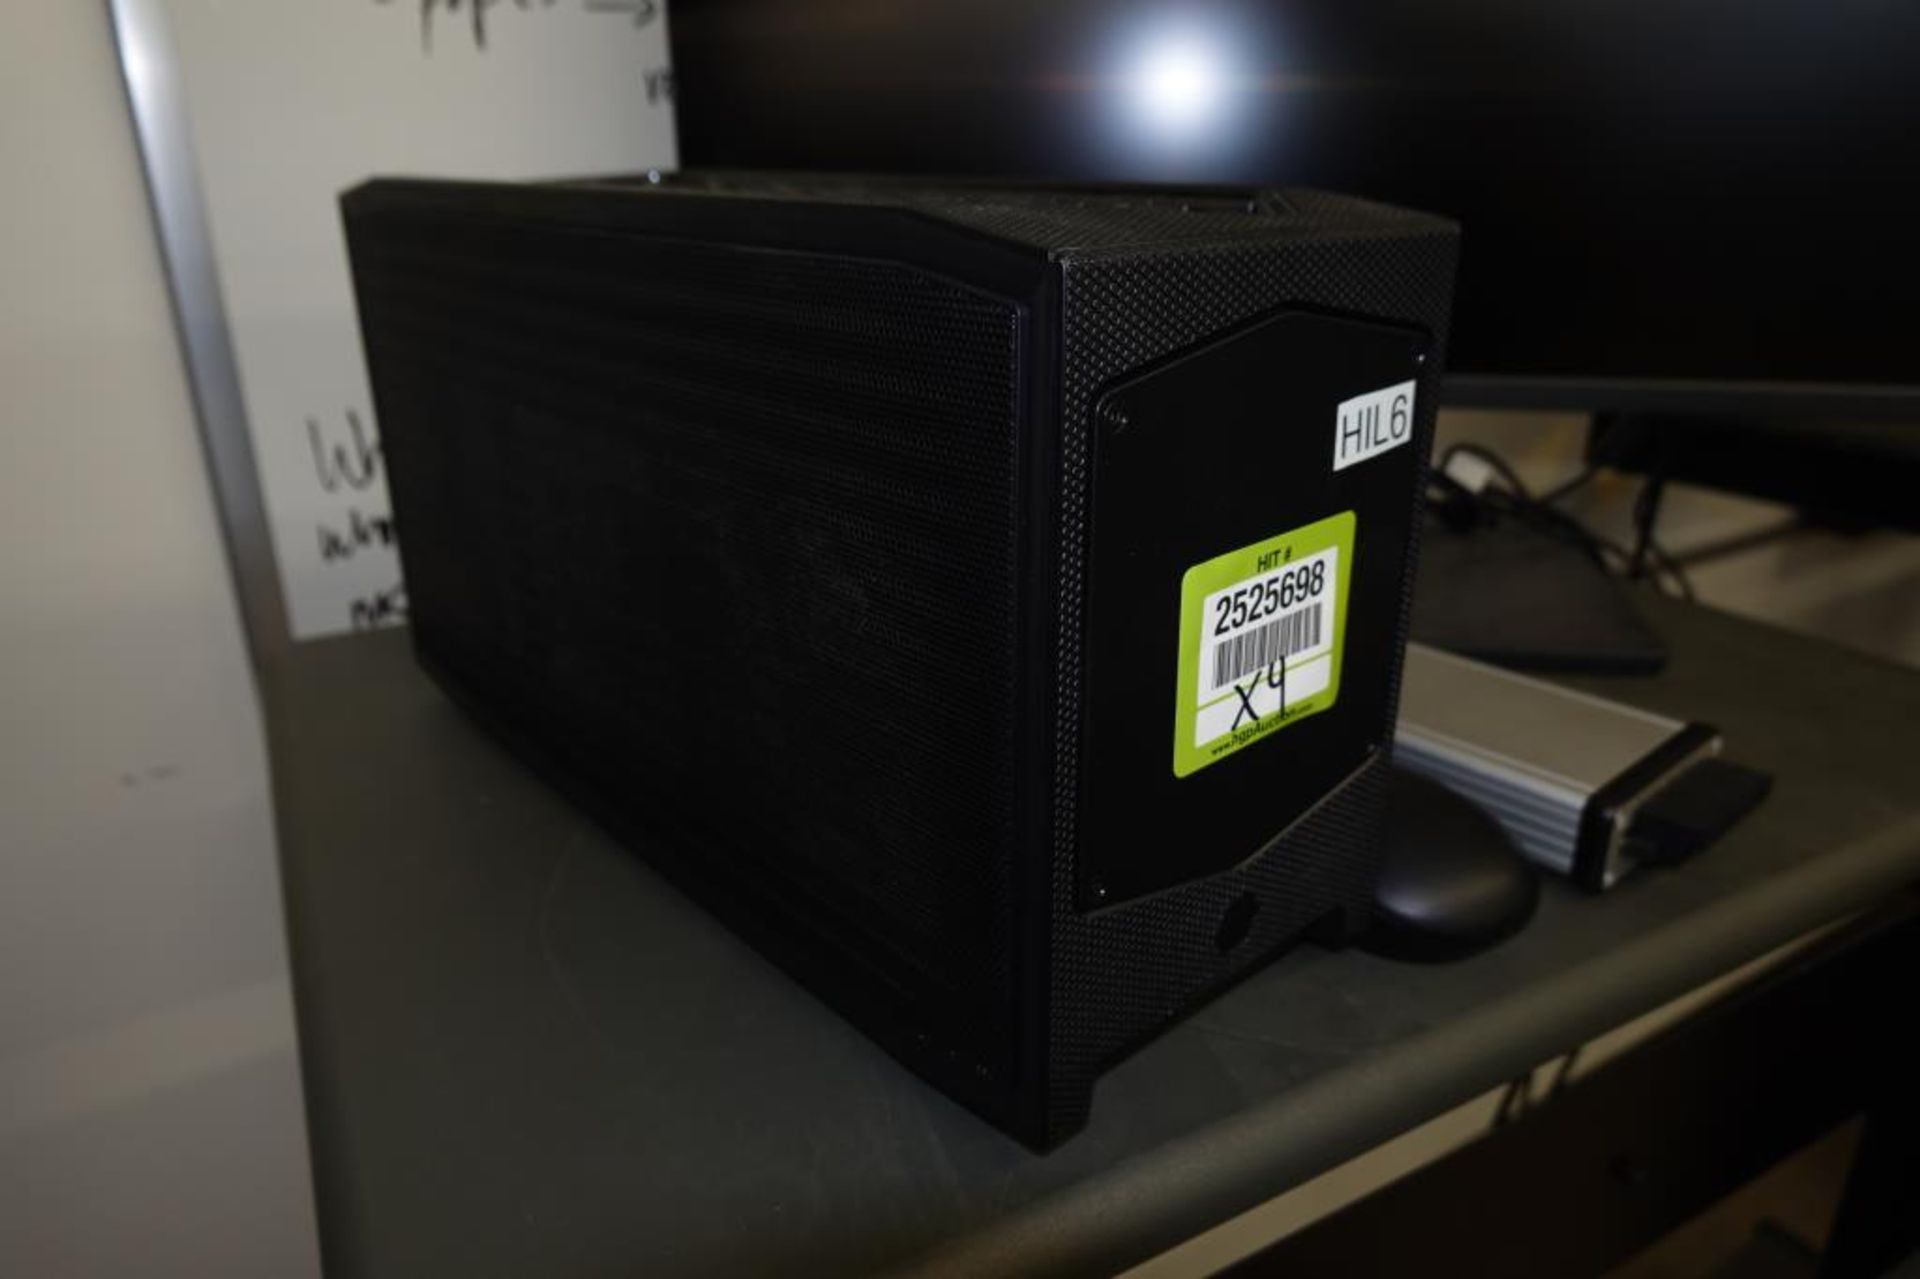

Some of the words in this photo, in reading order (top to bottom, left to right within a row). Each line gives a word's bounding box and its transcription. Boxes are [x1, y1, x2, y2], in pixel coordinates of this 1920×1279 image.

[1341, 394, 1407, 459] HIL6
[1257, 549, 1282, 573] HIT
[1214, 560, 1325, 636] 2525698
